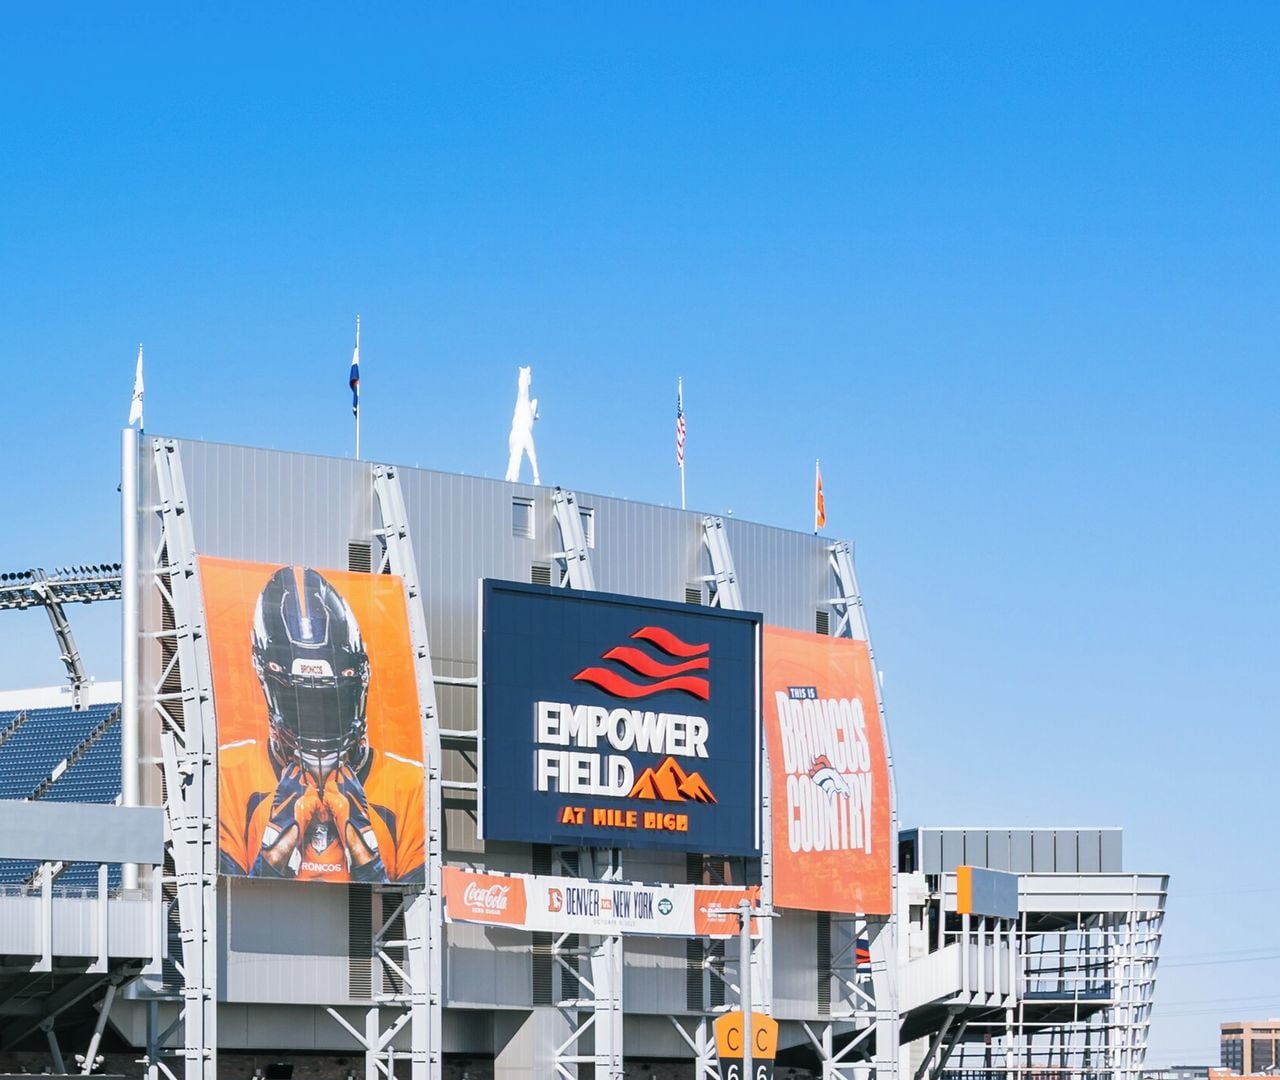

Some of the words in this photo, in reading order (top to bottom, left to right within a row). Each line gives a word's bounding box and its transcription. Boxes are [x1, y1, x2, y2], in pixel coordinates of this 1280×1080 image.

[790, 688, 806, 698] THIS
[807, 688, 815, 698] IS
[534, 701, 709, 758] EMPOWER
[775, 691, 871, 774] BRONCOS
[533, 749, 634, 797] FIELD
[558, 806, 586, 825] AT
[593, 808, 637, 828] MILE
[644, 811, 688, 832] HIGH
[786, 773, 872, 855] COUNTRY
[302, 862, 342, 872] RONCOS
[566, 887, 600, 916] DENVER
[613, 890, 631, 918] NEW
[634, 891, 654, 919] YORK
[727, 1028, 739, 1051] C
[756, 1028, 768, 1052] C
